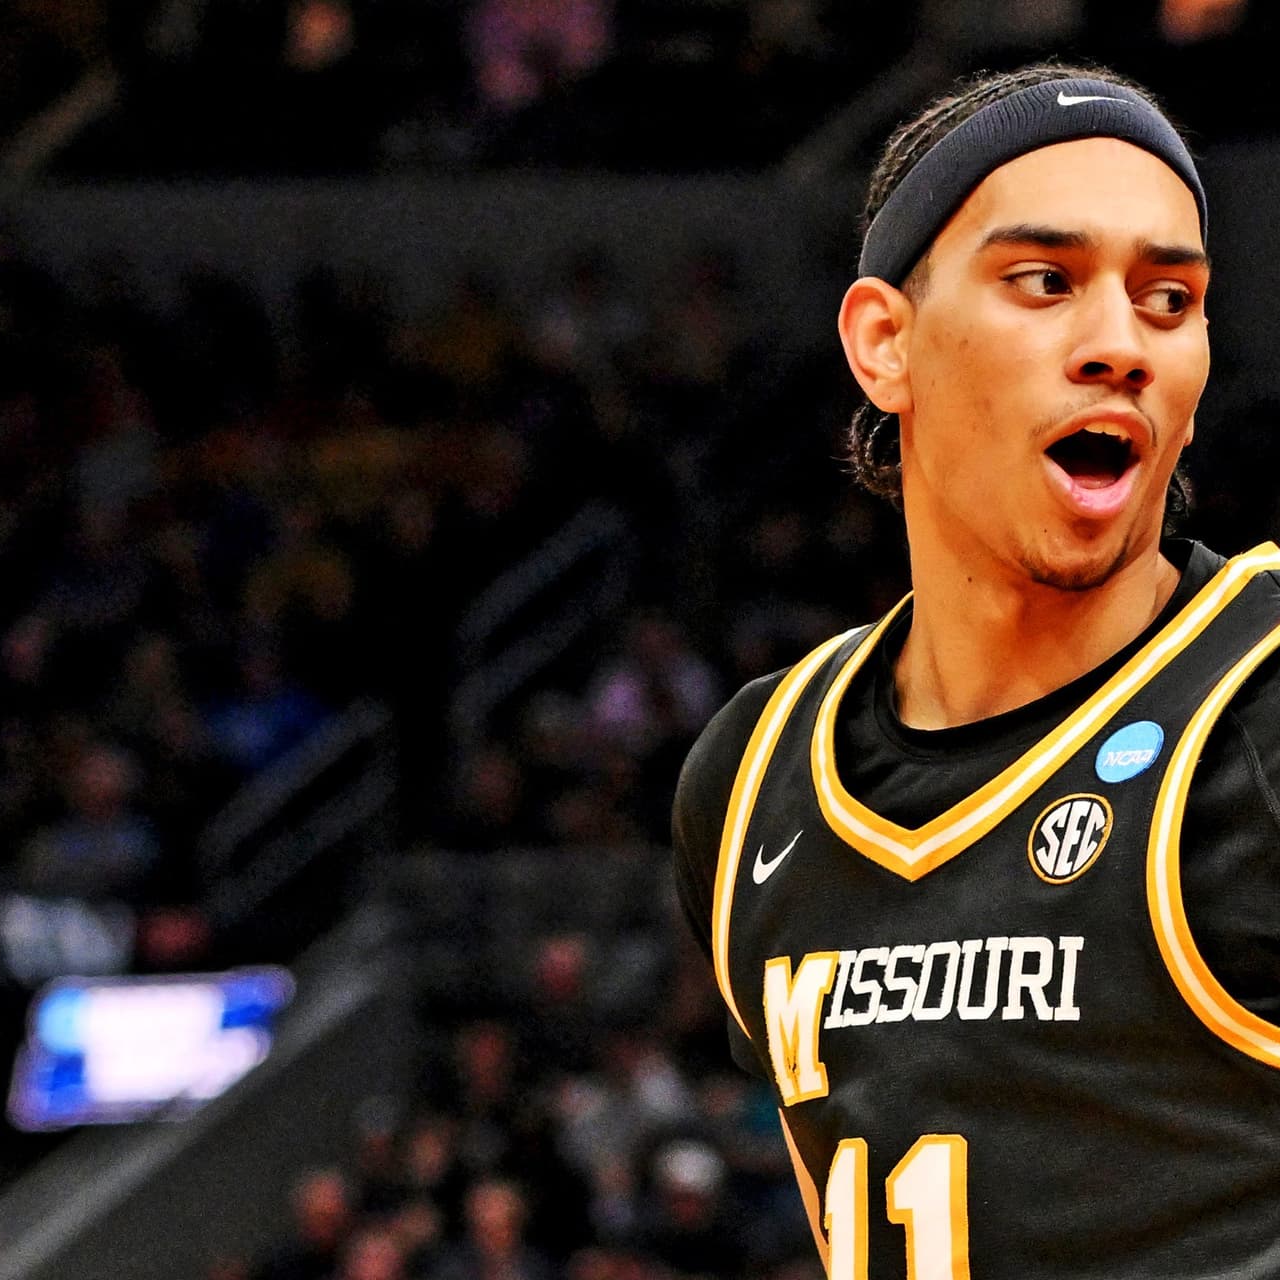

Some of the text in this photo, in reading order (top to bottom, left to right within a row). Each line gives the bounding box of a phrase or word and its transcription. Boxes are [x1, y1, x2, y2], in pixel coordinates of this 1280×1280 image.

[1103, 748, 1154, 768] NCAA
[1035, 800, 1106, 877] SEC
[764, 935, 1085, 1107] MISSOURI
